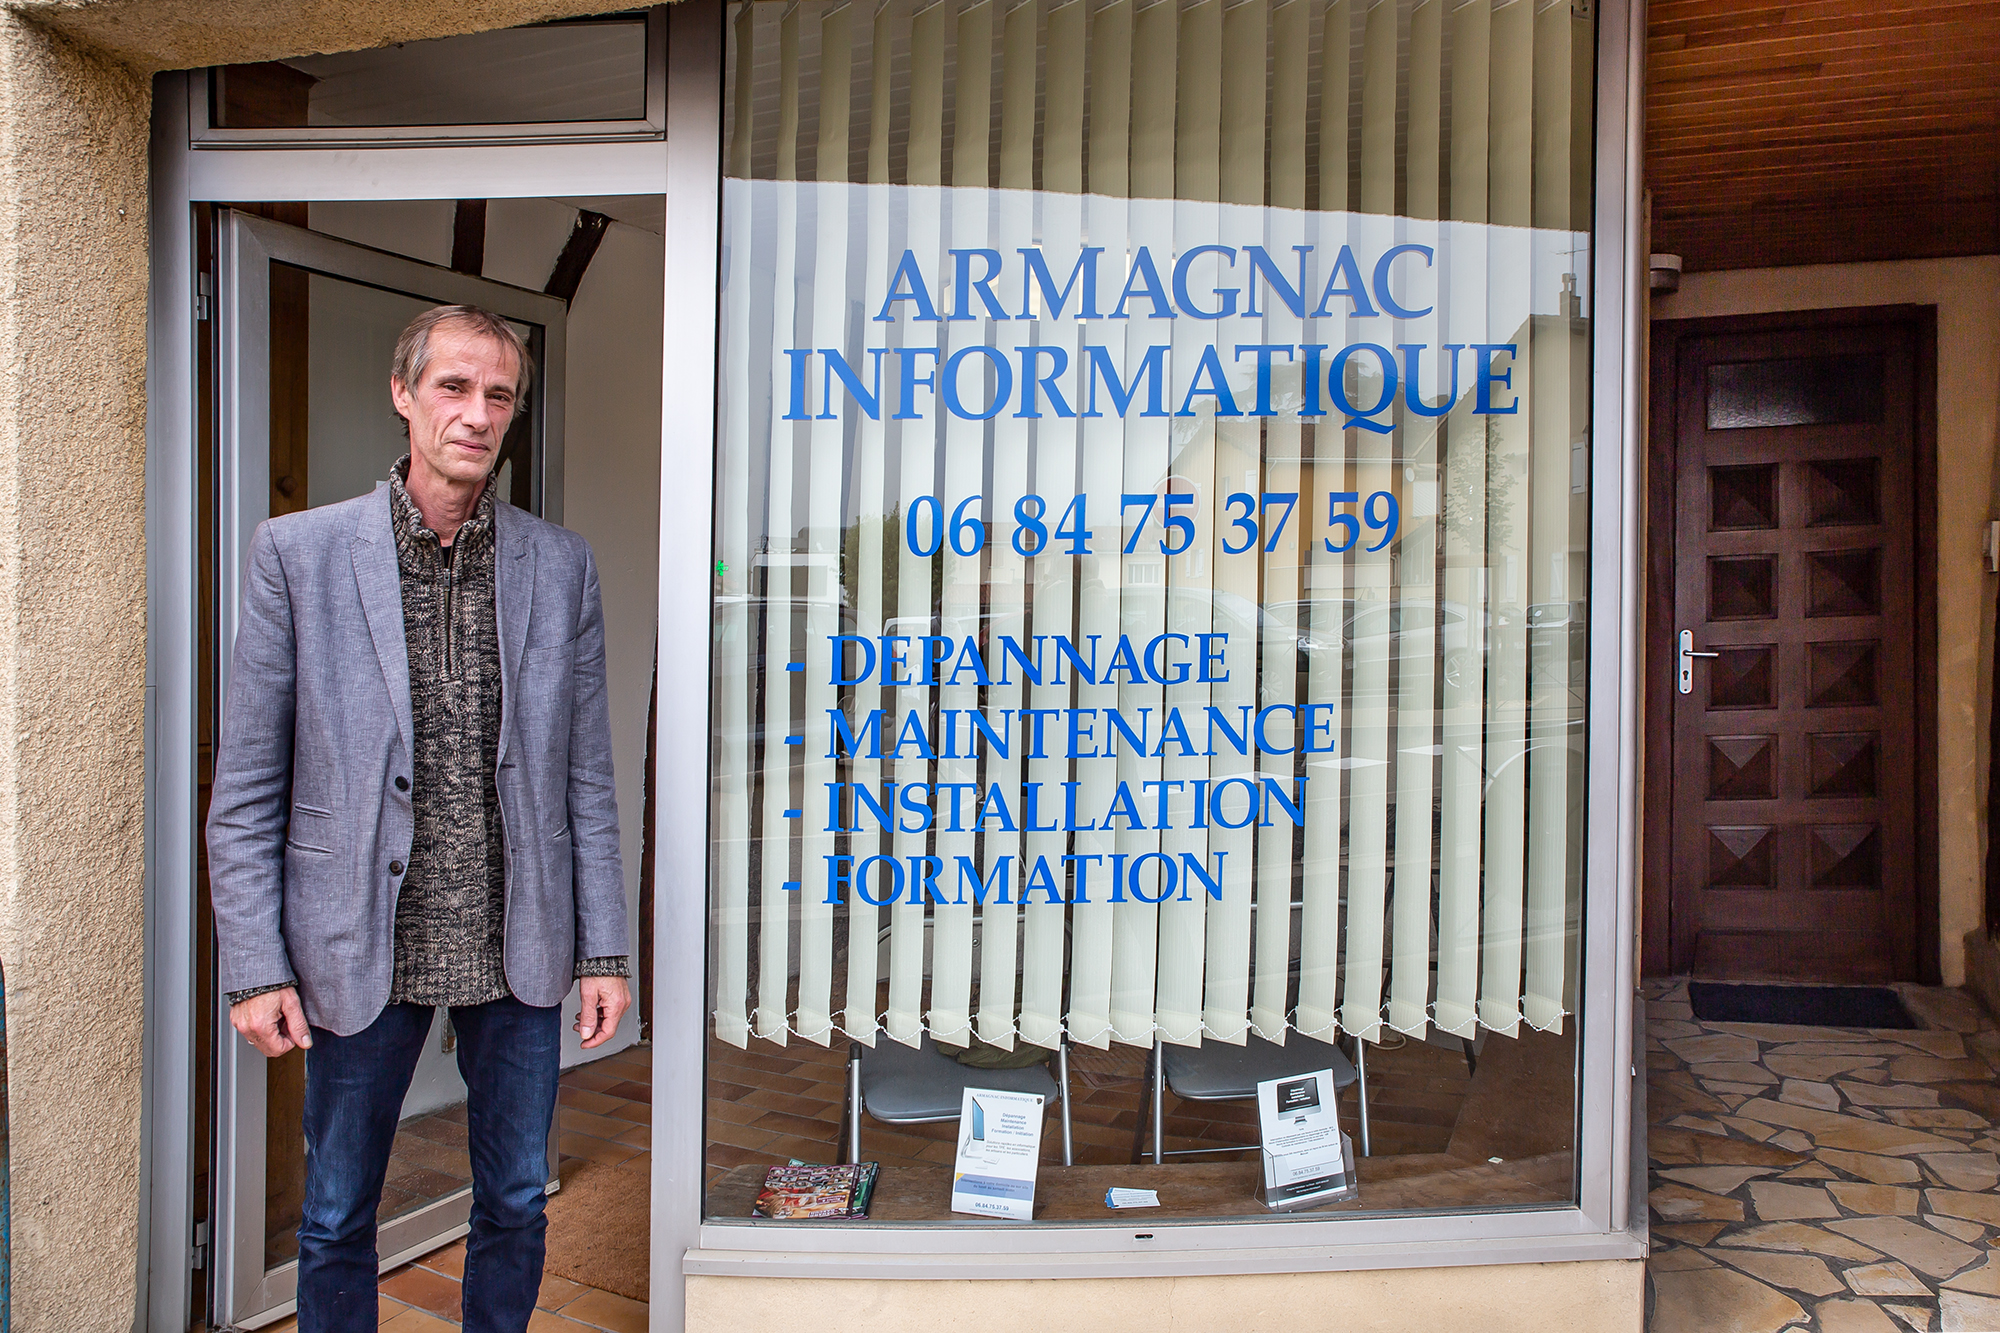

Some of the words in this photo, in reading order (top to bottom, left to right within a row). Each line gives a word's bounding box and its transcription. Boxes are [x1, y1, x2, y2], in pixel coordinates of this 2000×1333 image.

[872, 244, 1435, 322] ARMAGNAC
[781, 342, 1520, 435] INFORMATIQUE
[906, 494, 986, 558] 06
[1011, 493, 1093, 557] 84
[1120, 493, 1196, 556] 75
[1222, 492, 1299, 555] 37
[1324, 491, 1400, 554] 59
[826, 632, 1231, 687] DEPANNAGE
[824, 703, 1336, 760] MAINTENANCE
[822, 776, 1311, 834] INSTALLATION
[821, 851, 1230, 907] FORMATION
